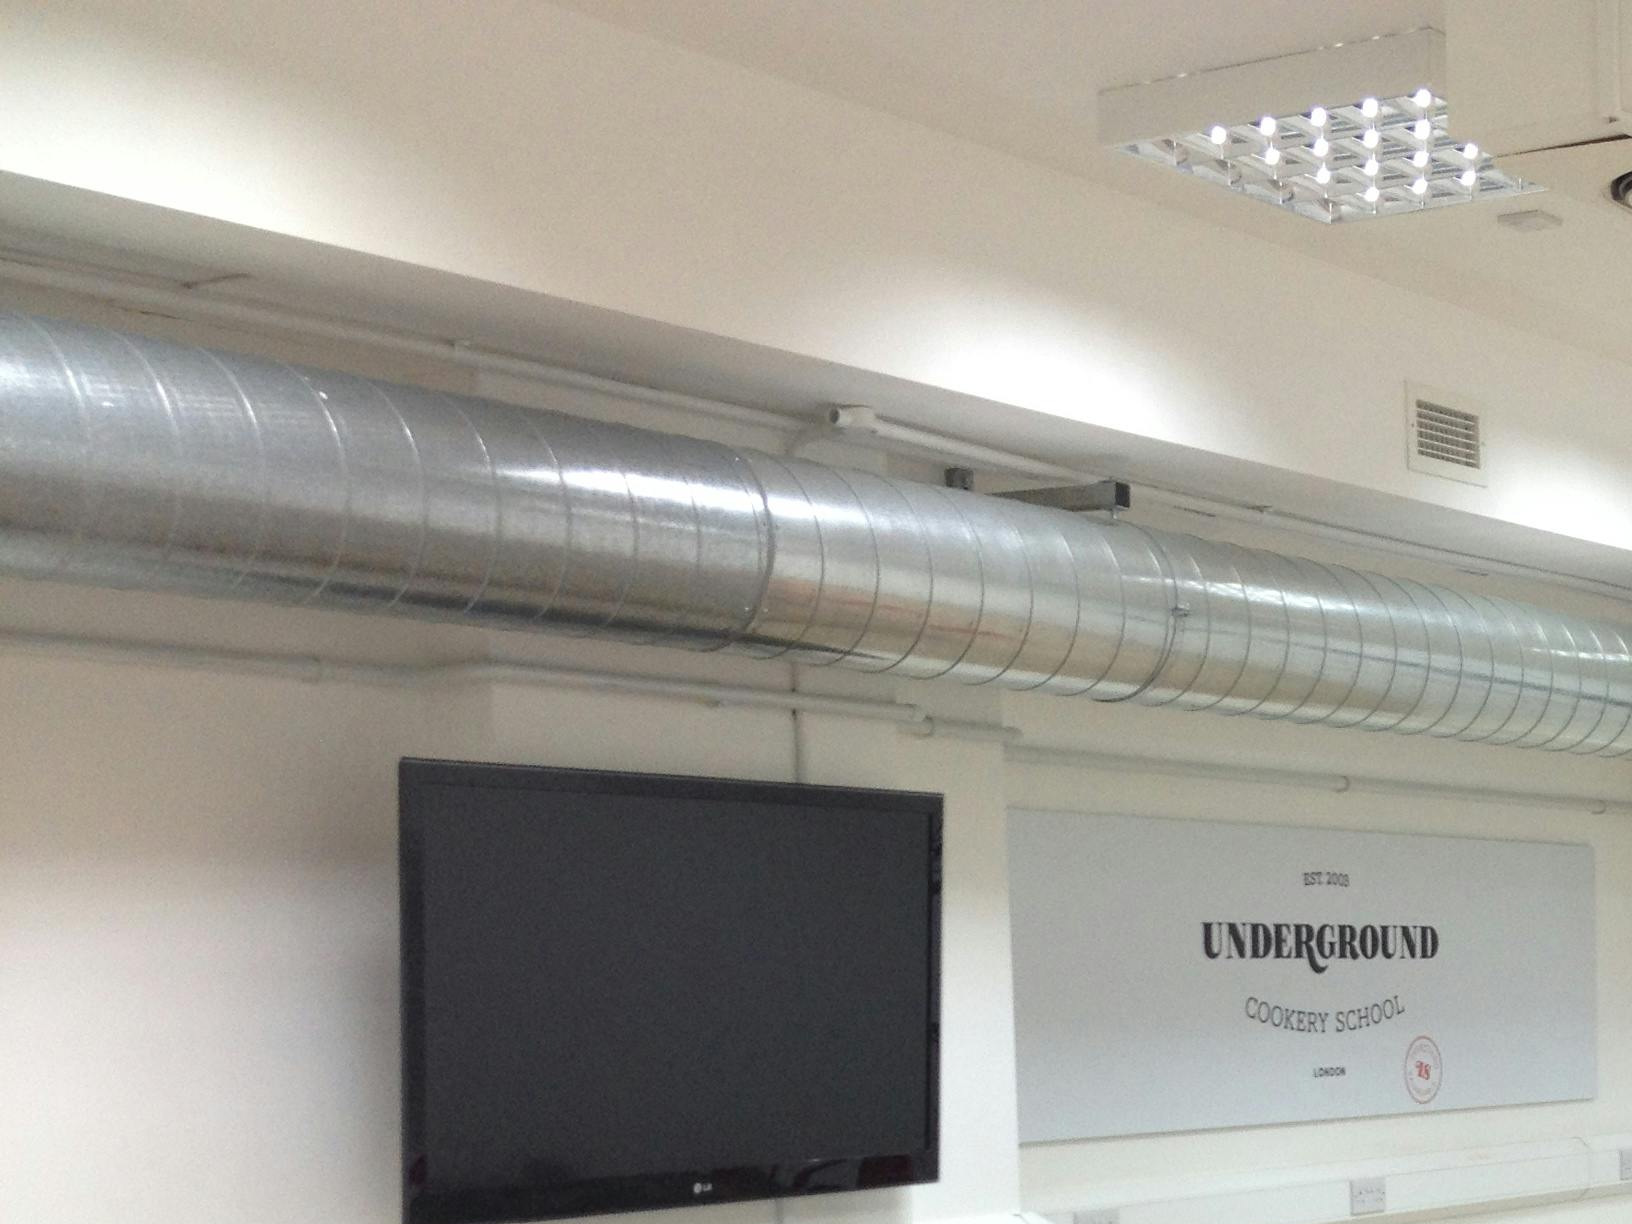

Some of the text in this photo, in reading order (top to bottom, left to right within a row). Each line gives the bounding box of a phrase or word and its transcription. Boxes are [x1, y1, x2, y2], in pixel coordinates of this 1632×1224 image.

[1201, 921, 1440, 975] UNDERGROUND
[1244, 995, 1406, 1034] COOKERY SCHOOL
[1312, 1066, 1347, 1079] LONDON
